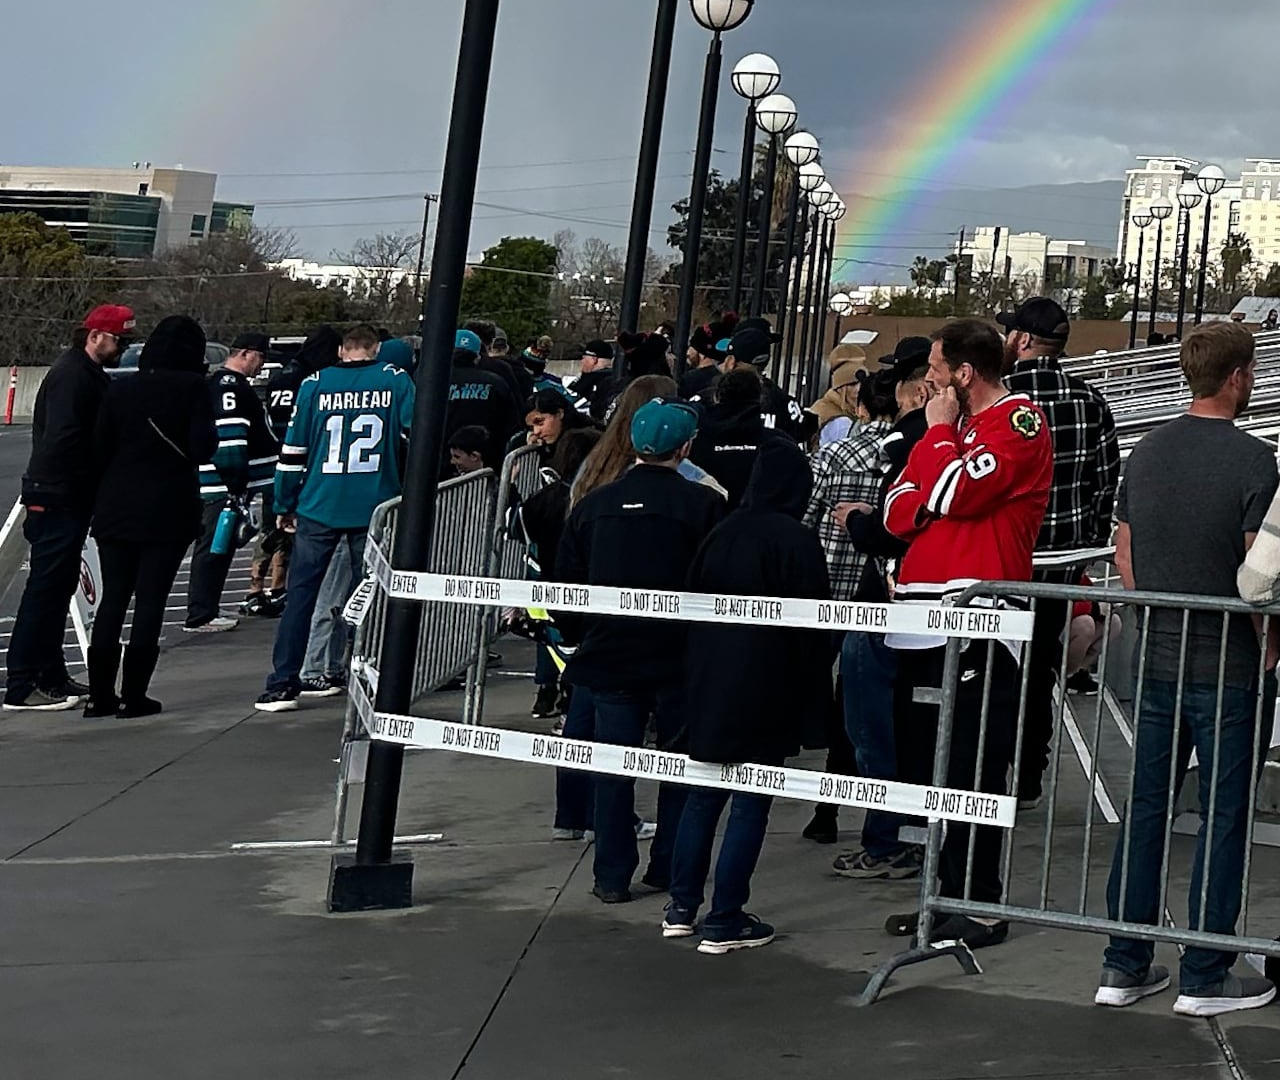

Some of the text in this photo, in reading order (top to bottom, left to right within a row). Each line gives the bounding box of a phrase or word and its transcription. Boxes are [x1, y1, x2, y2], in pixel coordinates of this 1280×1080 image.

[222, 392, 236, 410] 6
[270, 390, 294, 407] 72
[319, 391, 392, 411] MARLEAU
[322, 414, 383, 474] 12
[392, 574, 417, 594] ENTER
[445, 578, 501, 601] DO NOT ENTER
[532, 585, 590, 606] DO NOT ENTER
[620, 592, 680, 614] DO NOT ENTER
[715, 598, 782, 620] DO NOT ENTER
[818, 604, 888, 627] DO NOT ENTER
[928, 610, 1001, 633] DO NOT ENTER
[388, 719, 414, 739] ENTER
[443, 726, 501, 751] DO NOT ENTER
[532, 739, 593, 764] DO NOT ENTER
[623, 751, 686, 777] DO NOT ENTER
[721, 764, 786, 790] DO NOT ENTER
[819, 777, 887, 804] DO NOT ENTER
[925, 791, 998, 819] DO NOT ENTER
